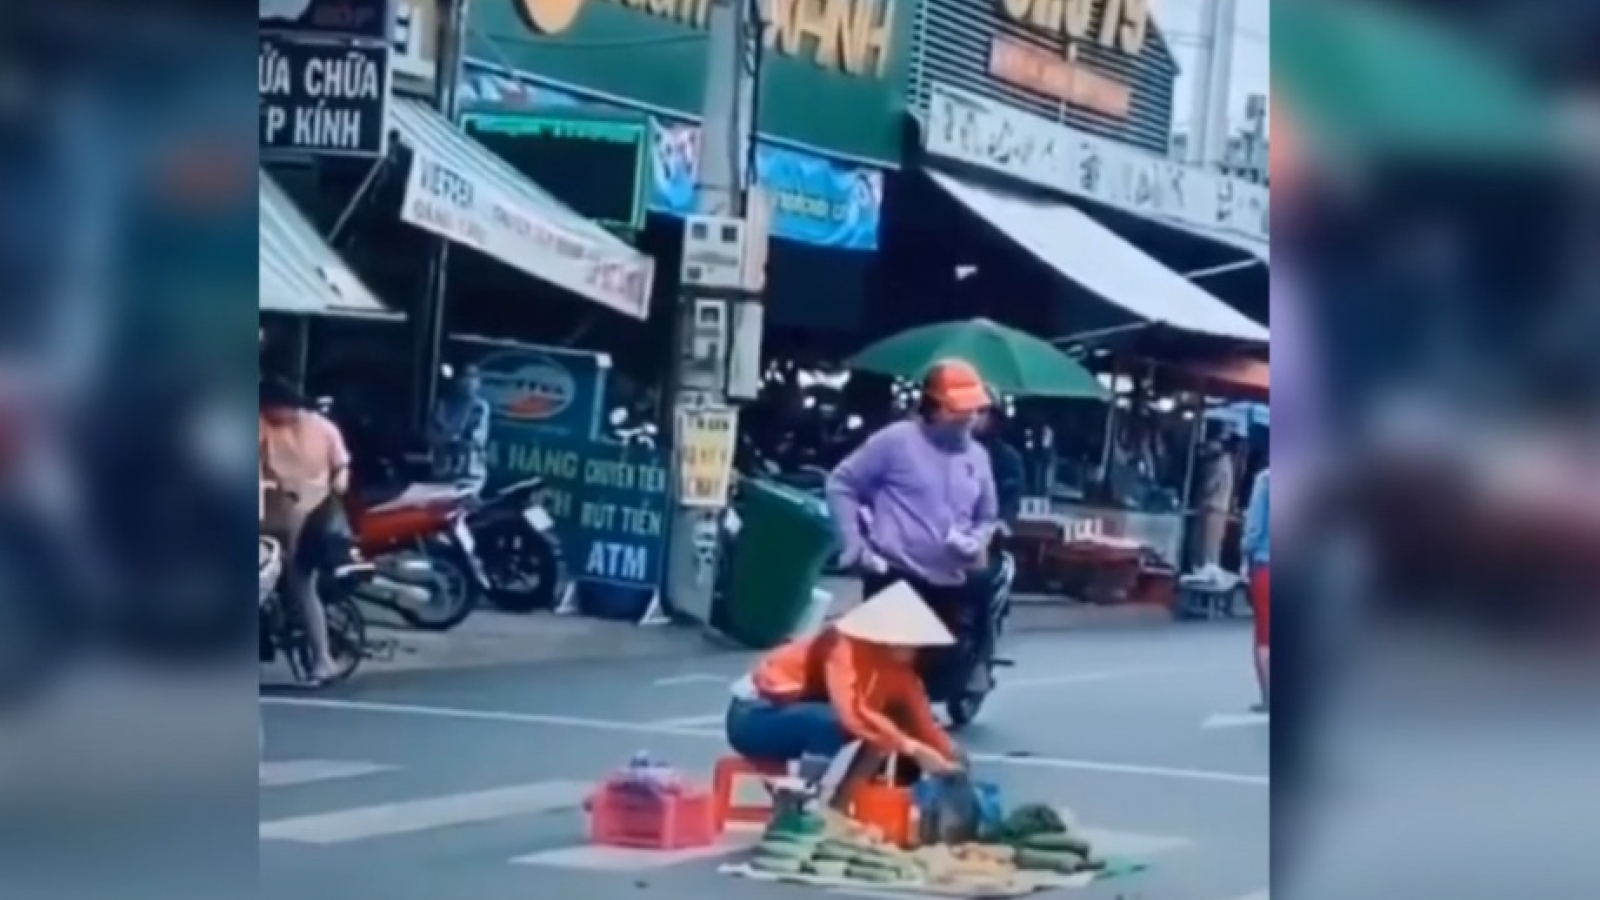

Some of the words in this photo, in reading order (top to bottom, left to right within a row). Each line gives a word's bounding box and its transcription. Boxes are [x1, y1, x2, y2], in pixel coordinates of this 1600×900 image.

[304, 51, 379, 99] CHỮA
[294, 99, 361, 148] KÍNH
[586, 541, 648, 580] ATM
